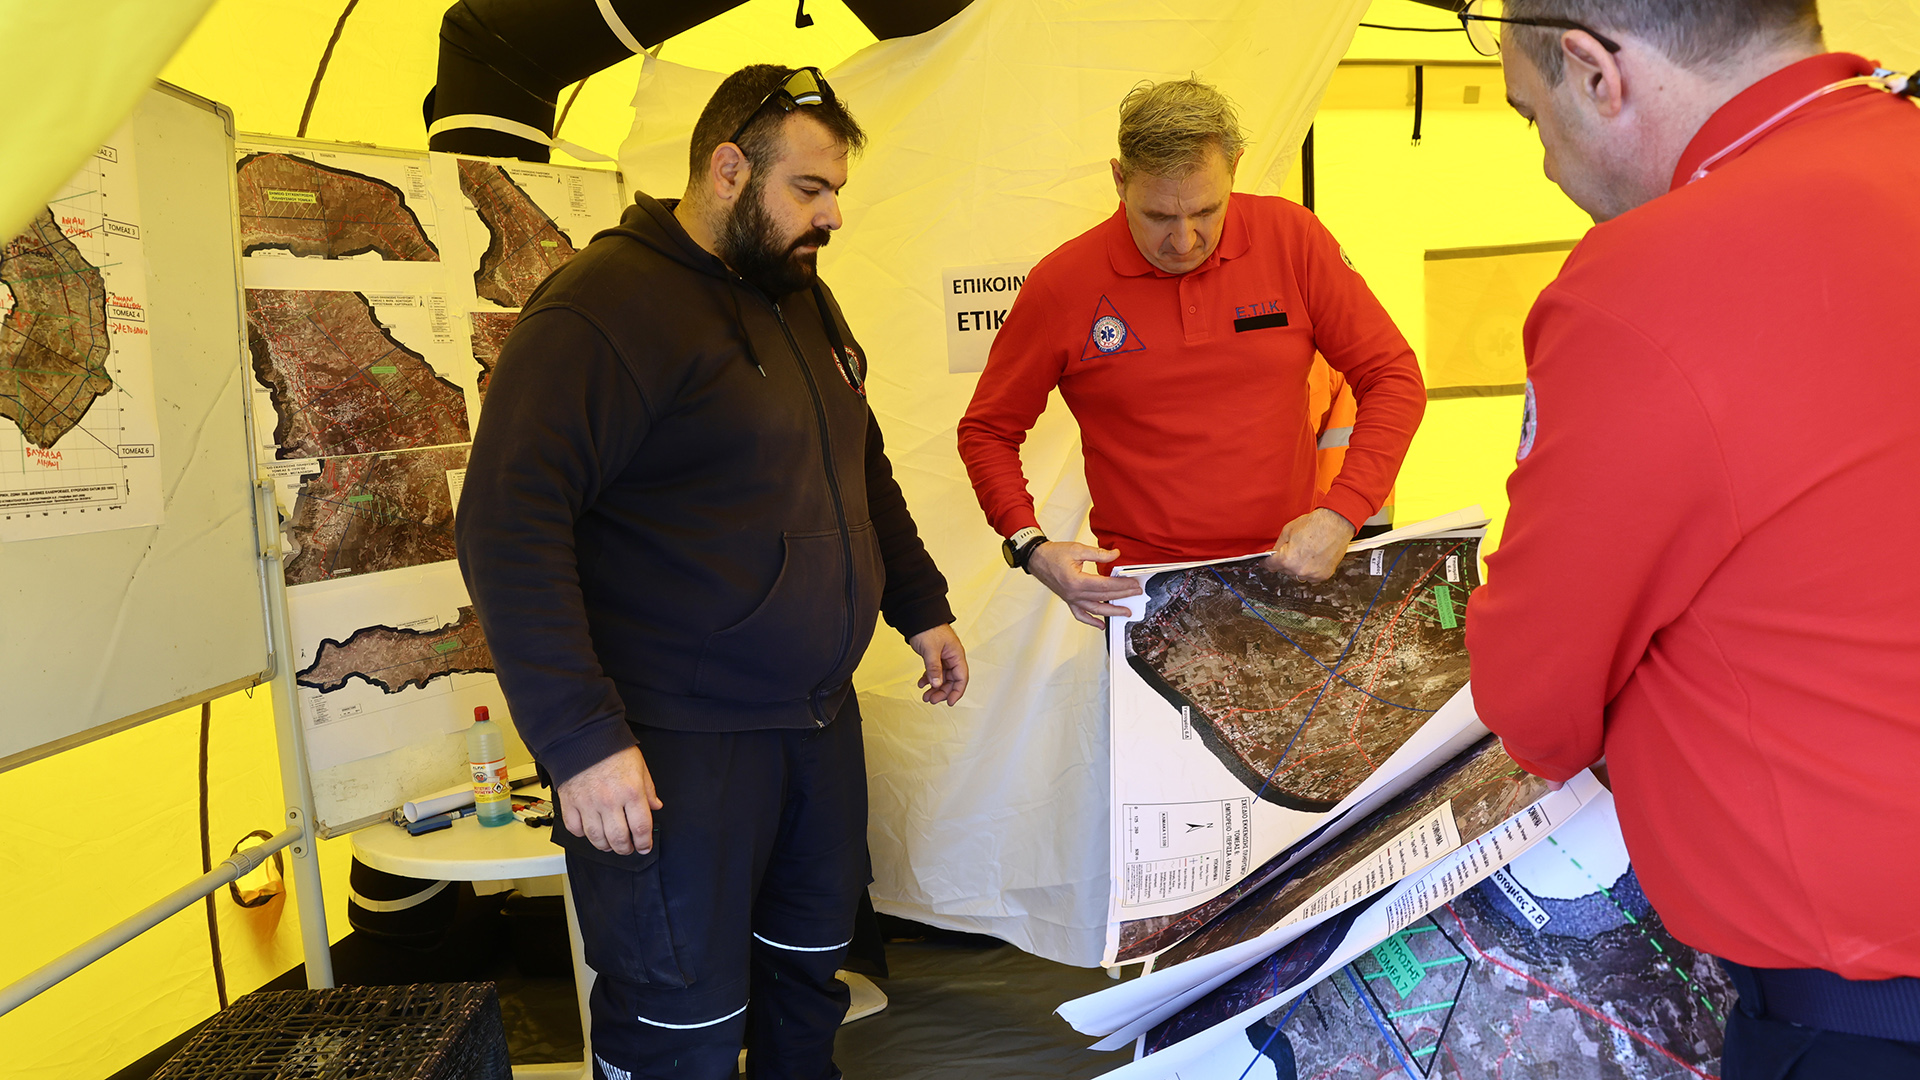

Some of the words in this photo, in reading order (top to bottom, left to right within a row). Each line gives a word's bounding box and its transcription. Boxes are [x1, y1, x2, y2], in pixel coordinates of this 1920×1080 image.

[108, 223, 130, 234] ΤΟΜΕΑΣ
[112, 309, 135, 318] ΤΟΜΕΑΣ
[958, 309, 1007, 332] ΕΤΙΚ
